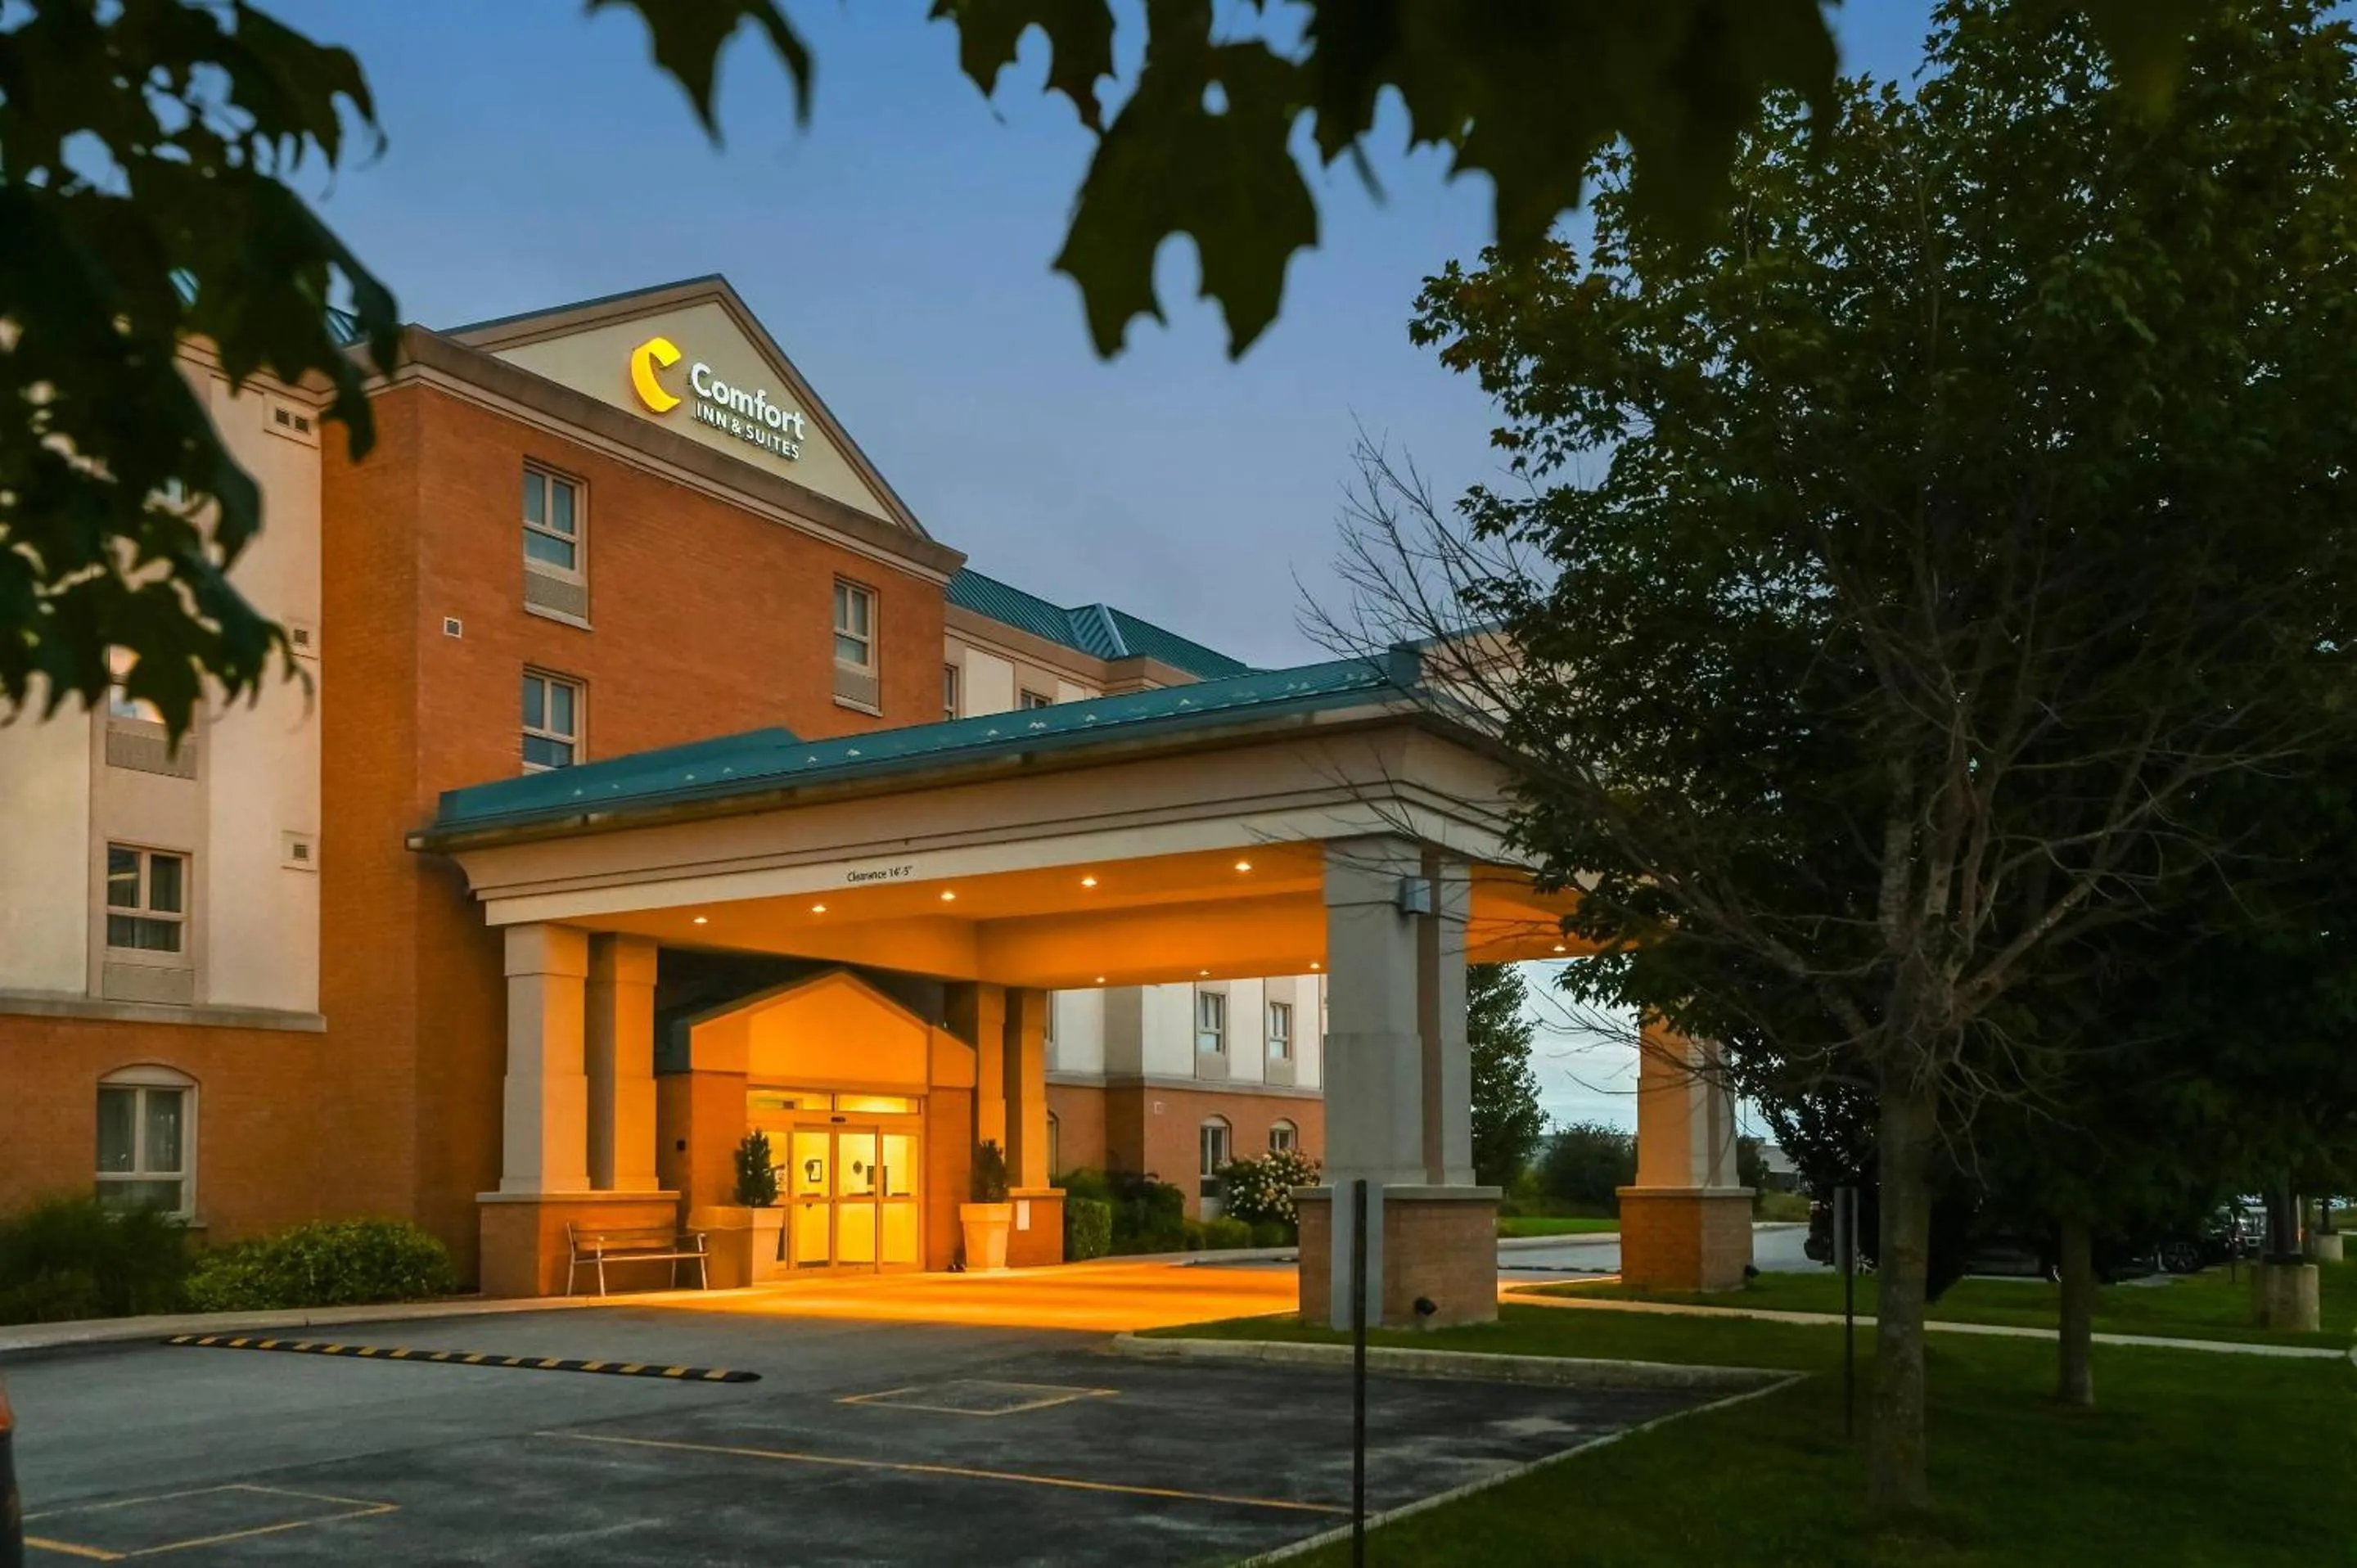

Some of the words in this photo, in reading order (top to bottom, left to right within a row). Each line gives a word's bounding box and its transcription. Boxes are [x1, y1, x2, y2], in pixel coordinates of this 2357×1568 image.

[691, 363, 804, 439] Comfort
[696, 402, 727, 428] INN
[732, 418, 741, 435] &
[746, 425, 800, 460] SUITES
[847, 870, 886, 882] Clearance
